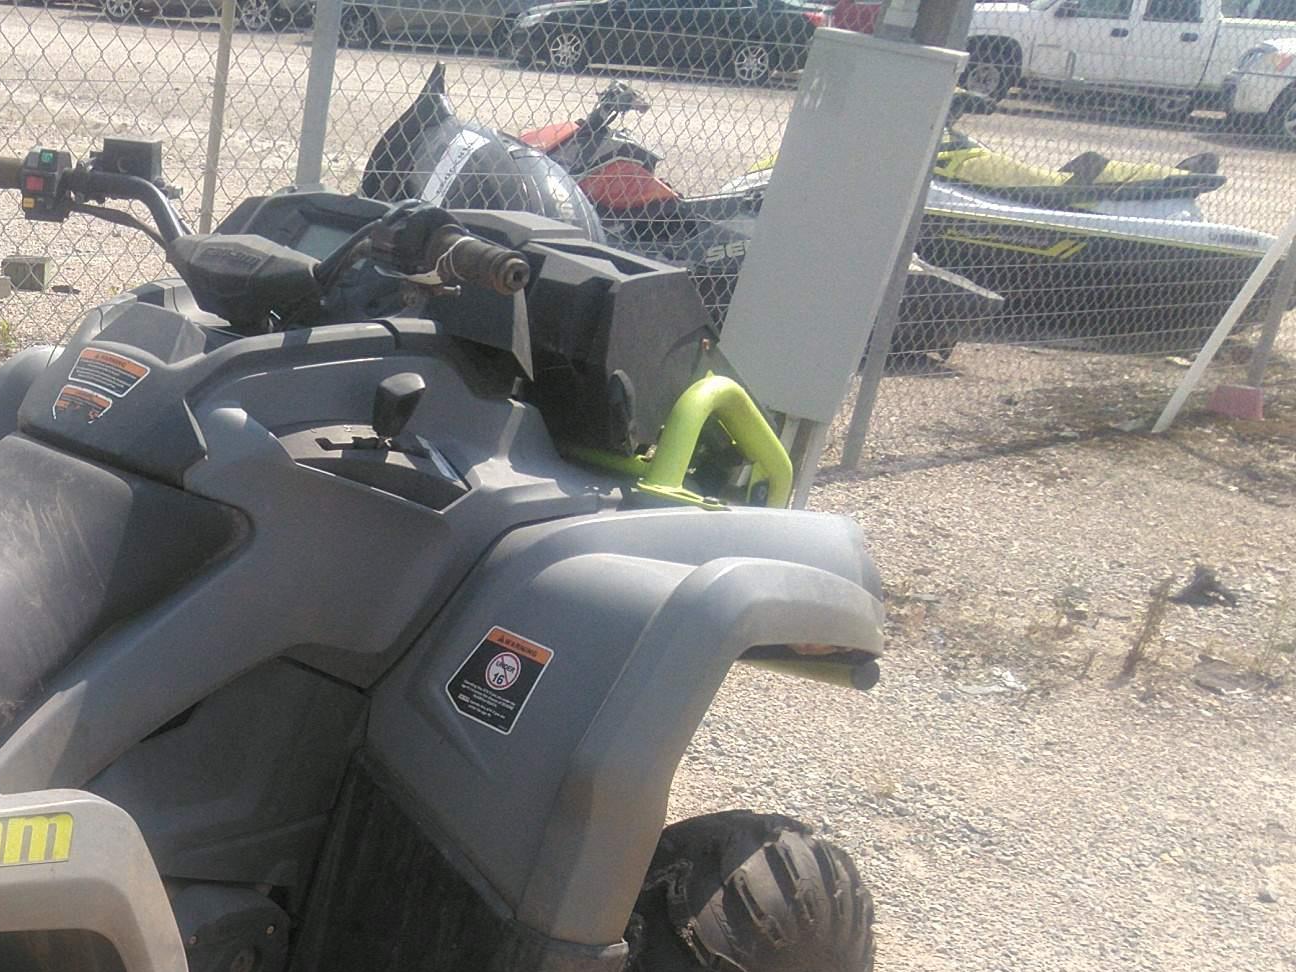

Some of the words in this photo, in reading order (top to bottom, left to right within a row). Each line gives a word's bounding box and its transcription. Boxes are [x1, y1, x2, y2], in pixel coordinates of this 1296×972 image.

[705, 239, 750, 263] SE
[495, 660, 516, 673] UNDER
[492, 672, 505, 685] 16
